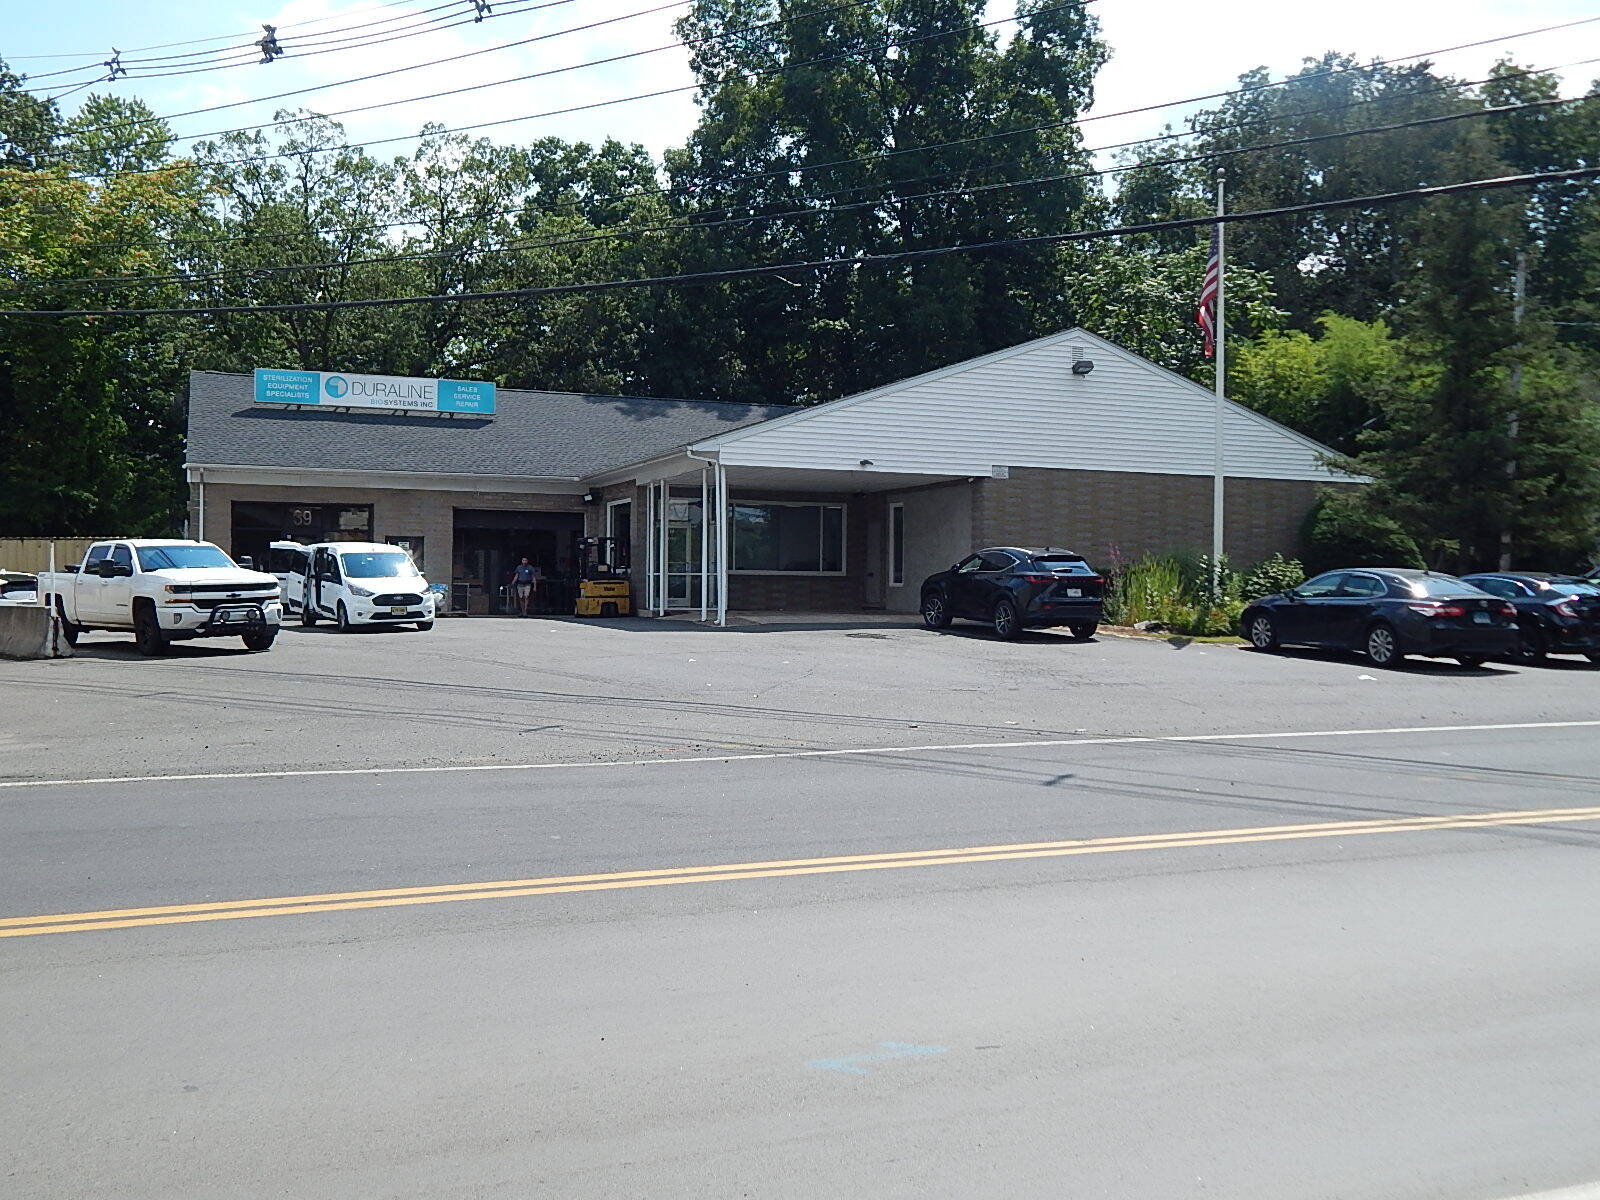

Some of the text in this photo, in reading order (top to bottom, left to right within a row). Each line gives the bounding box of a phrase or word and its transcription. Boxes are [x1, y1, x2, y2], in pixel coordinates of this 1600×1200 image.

[263, 374, 313, 383] STERILIZATION
[267, 382, 309, 390] EQUIPMENT
[457, 385, 478, 393] SALES
[265, 390, 310, 399] SPECIALISTS
[351, 381, 434, 400] DURALINE
[453, 393, 481, 401] SERVICE
[455, 400, 479, 408] REPAIR
[293, 509, 312, 526] 39
